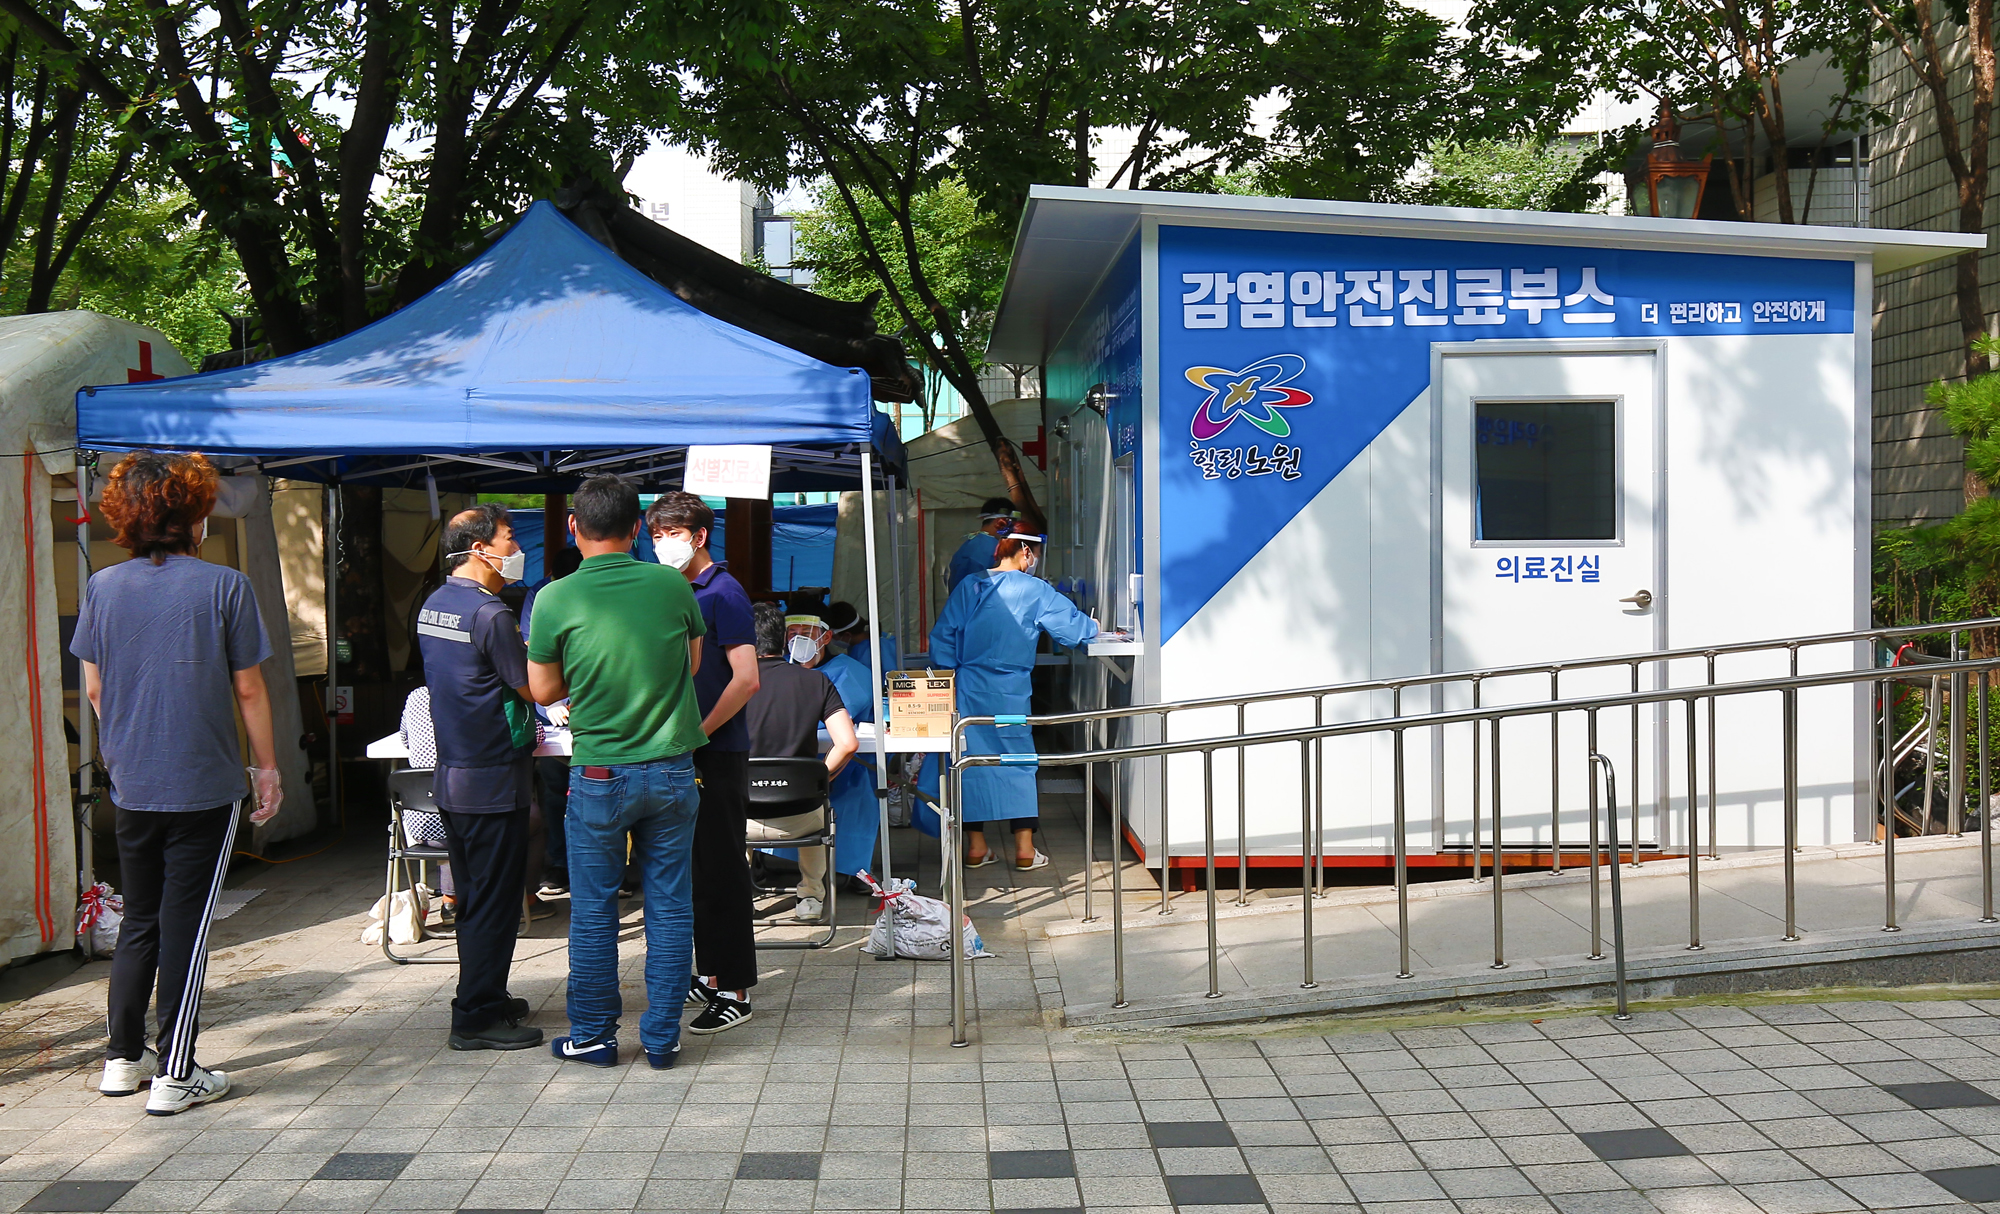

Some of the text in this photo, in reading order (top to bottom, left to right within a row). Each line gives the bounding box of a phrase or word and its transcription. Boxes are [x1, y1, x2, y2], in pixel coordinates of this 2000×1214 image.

[1182, 268, 1616, 329] 감염안전진료부스
[1641, 300, 1826, 325] 더 편리하고 안전하게
[692, 458, 764, 485] 선별진료소
[1495, 555, 1600, 583] 의료진실
[439, 611, 461, 629] DEFENSE
